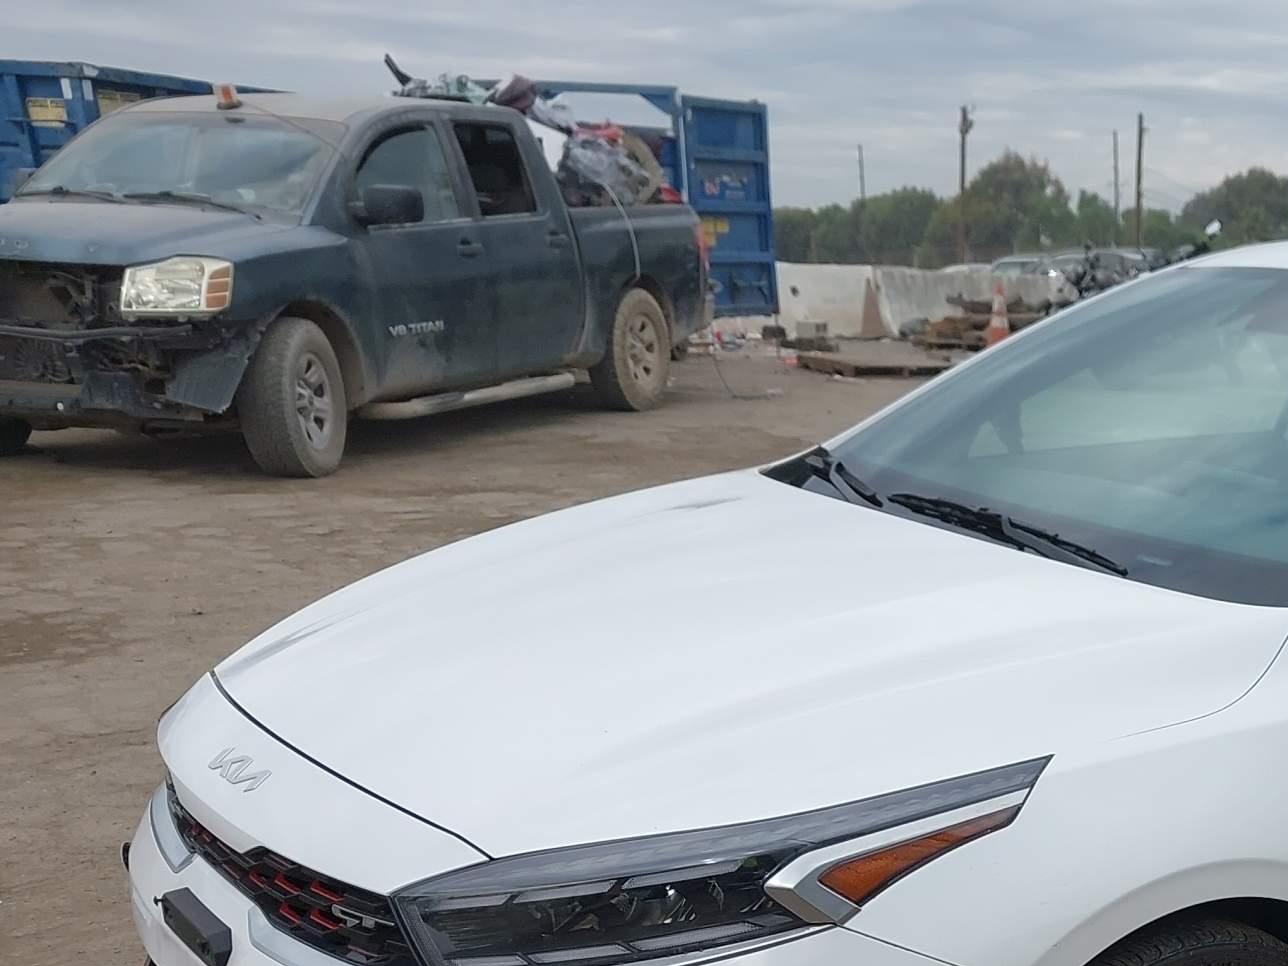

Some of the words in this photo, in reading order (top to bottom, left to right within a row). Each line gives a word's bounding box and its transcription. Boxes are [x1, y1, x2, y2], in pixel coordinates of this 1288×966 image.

[407, 320, 445, 335] TITAN
[207, 746, 273, 793] KIA
[331, 903, 395, 929] GT
